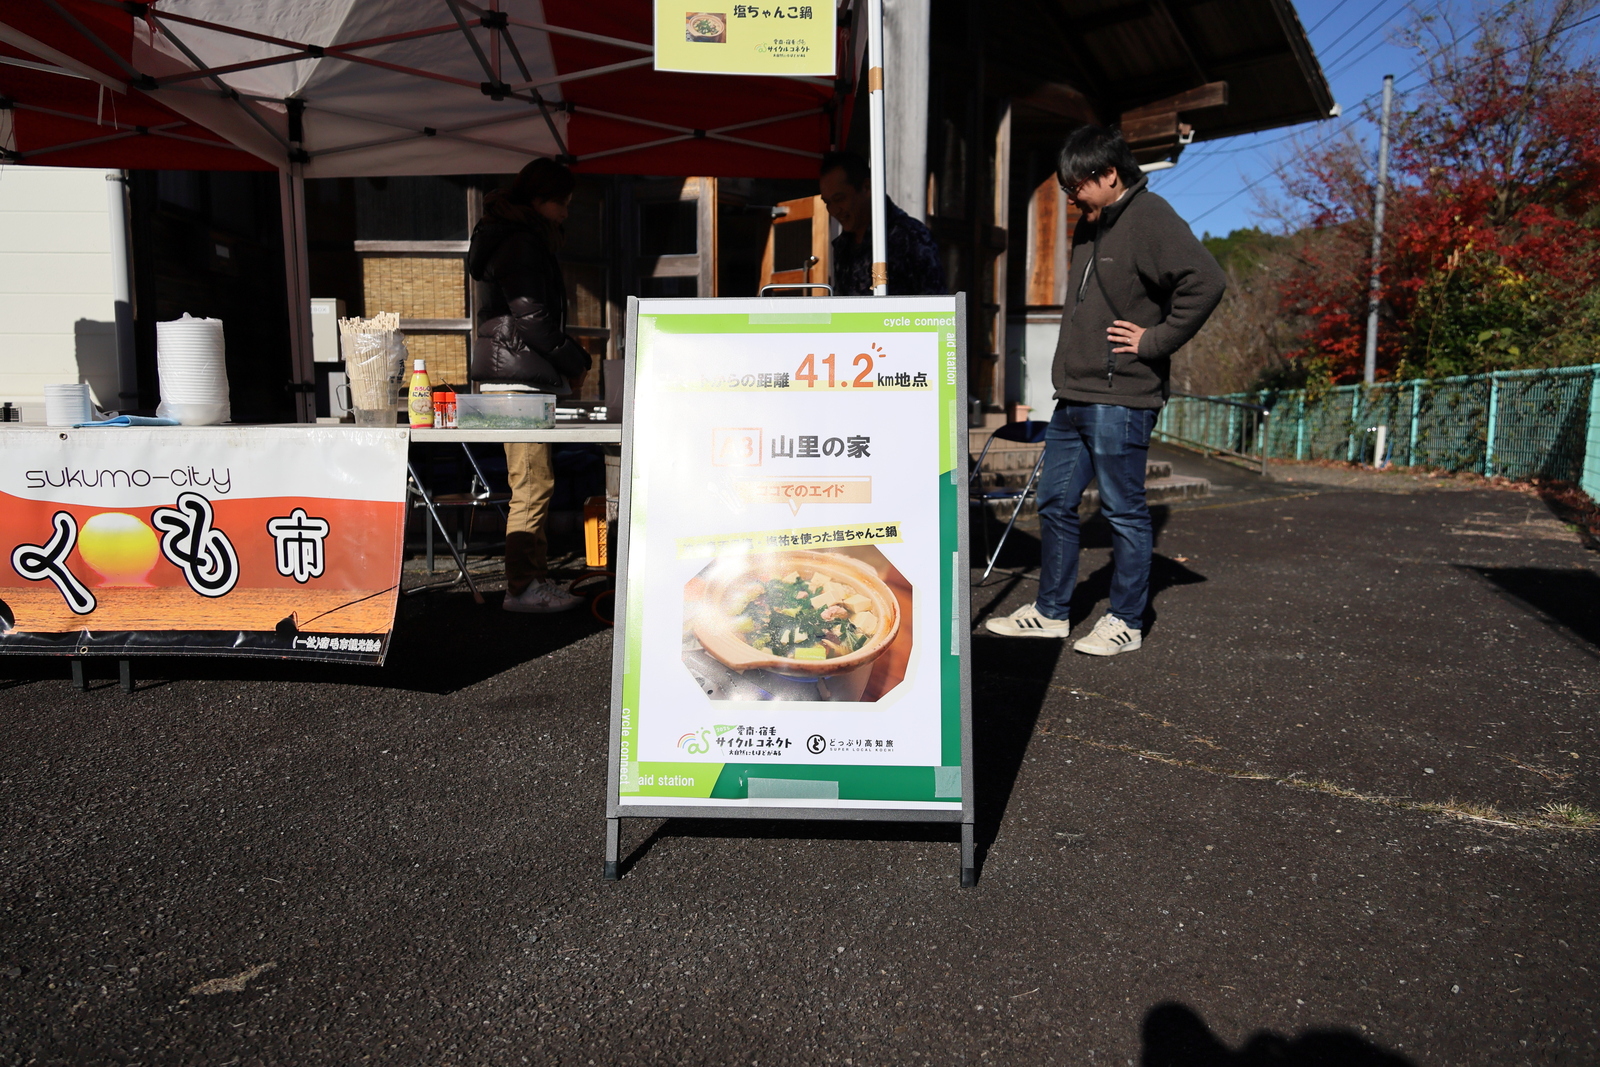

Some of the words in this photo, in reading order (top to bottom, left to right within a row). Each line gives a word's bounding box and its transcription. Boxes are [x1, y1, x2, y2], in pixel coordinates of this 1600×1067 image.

[733, 4, 813, 20] 塩ちゃんこ鍋
[883, 316, 911, 327] cycle
[914, 316, 956, 326] connect
[946, 332, 956, 347] aid
[795, 353, 874, 388] 41.2
[877, 371, 928, 388] km地点
[946, 351, 956, 385] station
[771, 434, 871, 459] 山里の家
[25, 466, 233, 494] sukumo-city
[756, 484, 845, 498] ココでのエイド
[621, 708, 632, 737] cycle
[716, 737, 793, 748] サイクルコネクト
[620, 741, 630, 785] connect
[638, 774, 654, 786] aid
[658, 774, 695, 787] station
